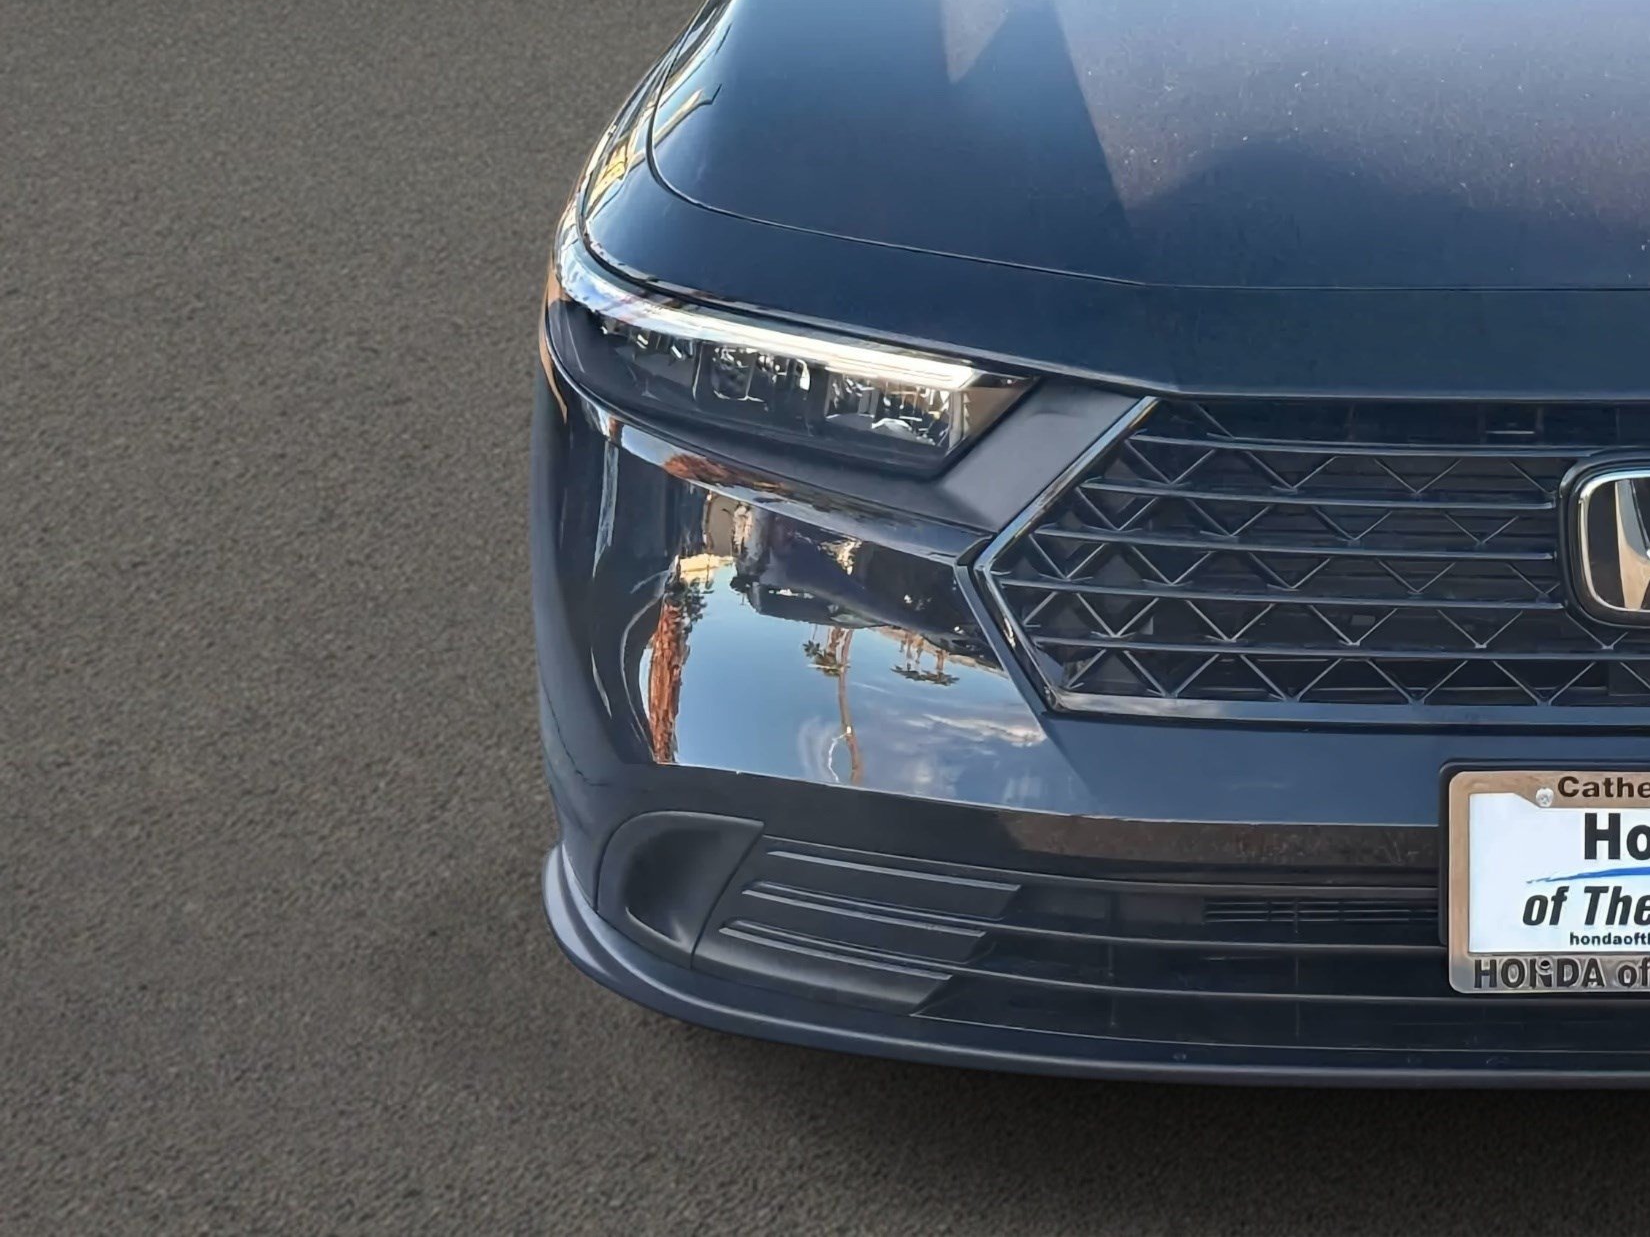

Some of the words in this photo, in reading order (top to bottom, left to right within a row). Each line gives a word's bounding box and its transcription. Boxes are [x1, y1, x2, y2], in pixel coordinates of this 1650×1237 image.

[1522, 885, 1570, 926] of
[1474, 957, 1605, 989] HONDA
[1617, 957, 1650, 988] of
